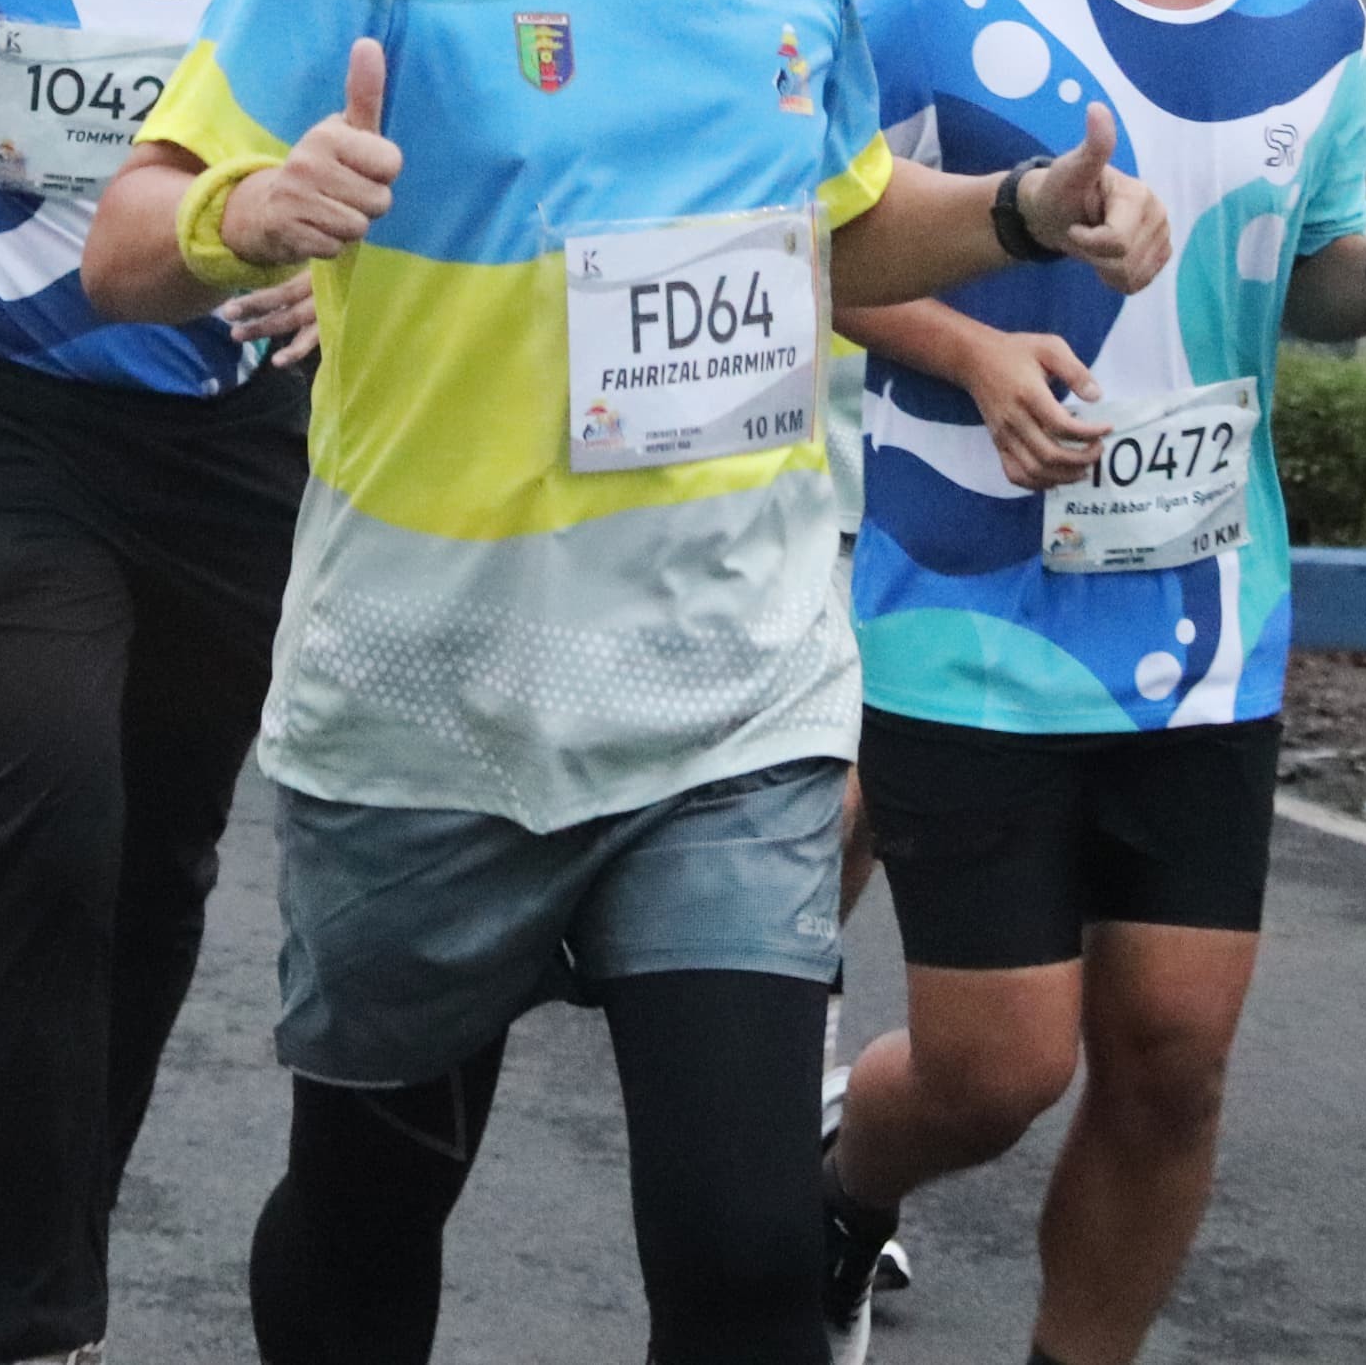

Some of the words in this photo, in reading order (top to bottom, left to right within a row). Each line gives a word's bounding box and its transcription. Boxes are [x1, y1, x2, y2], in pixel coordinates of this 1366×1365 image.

[27, 64, 165, 122] 1042
[66, 129, 124, 145] TOMMY
[630, 271, 774, 354] FD64
[601, 361, 702, 392] FAHRIZAL
[707, 346, 797, 380] DARMINTO
[743, 416, 768, 440] 10
[775, 409, 804, 435] KM
[1092, 422, 1234, 488] 10472
[1109, 500, 1152, 515] Akbar
[1192, 534, 1209, 554] 10
[1214, 523, 1241, 546] KM
